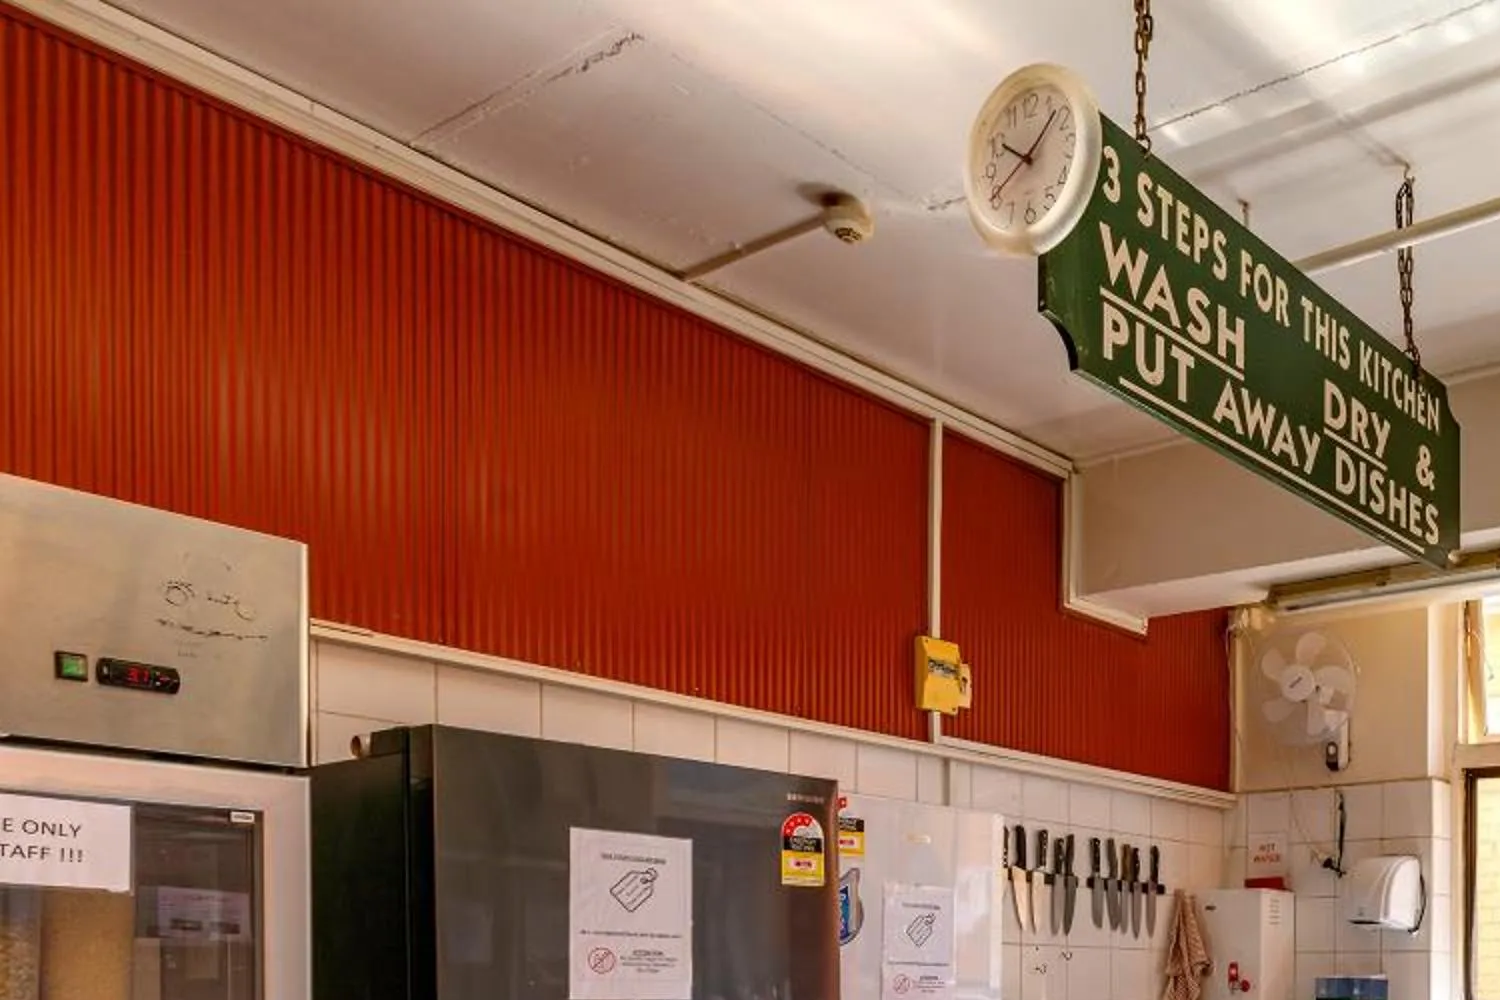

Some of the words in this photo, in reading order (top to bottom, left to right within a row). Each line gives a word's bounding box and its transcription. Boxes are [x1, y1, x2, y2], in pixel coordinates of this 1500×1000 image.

[1022, 93, 1039, 119] 12
[1099, 221, 1245, 370] WASH
[1324, 377, 1391, 459] DRY
[1416, 444, 1435, 491] &
[1102, 145, 1121, 203] 3
[1137, 171, 1228, 282] STEPS
[1240, 248, 1291, 328] FOR
[1301, 295, 1351, 371] THIS
[1359, 339, 1440, 437] KITCHEN
[1103, 301, 1195, 403] PUT
[1213, 378, 1321, 475] AWAY
[1335, 446, 1439, 545] DISHES
[22, 819, 82, 839] ONLY
